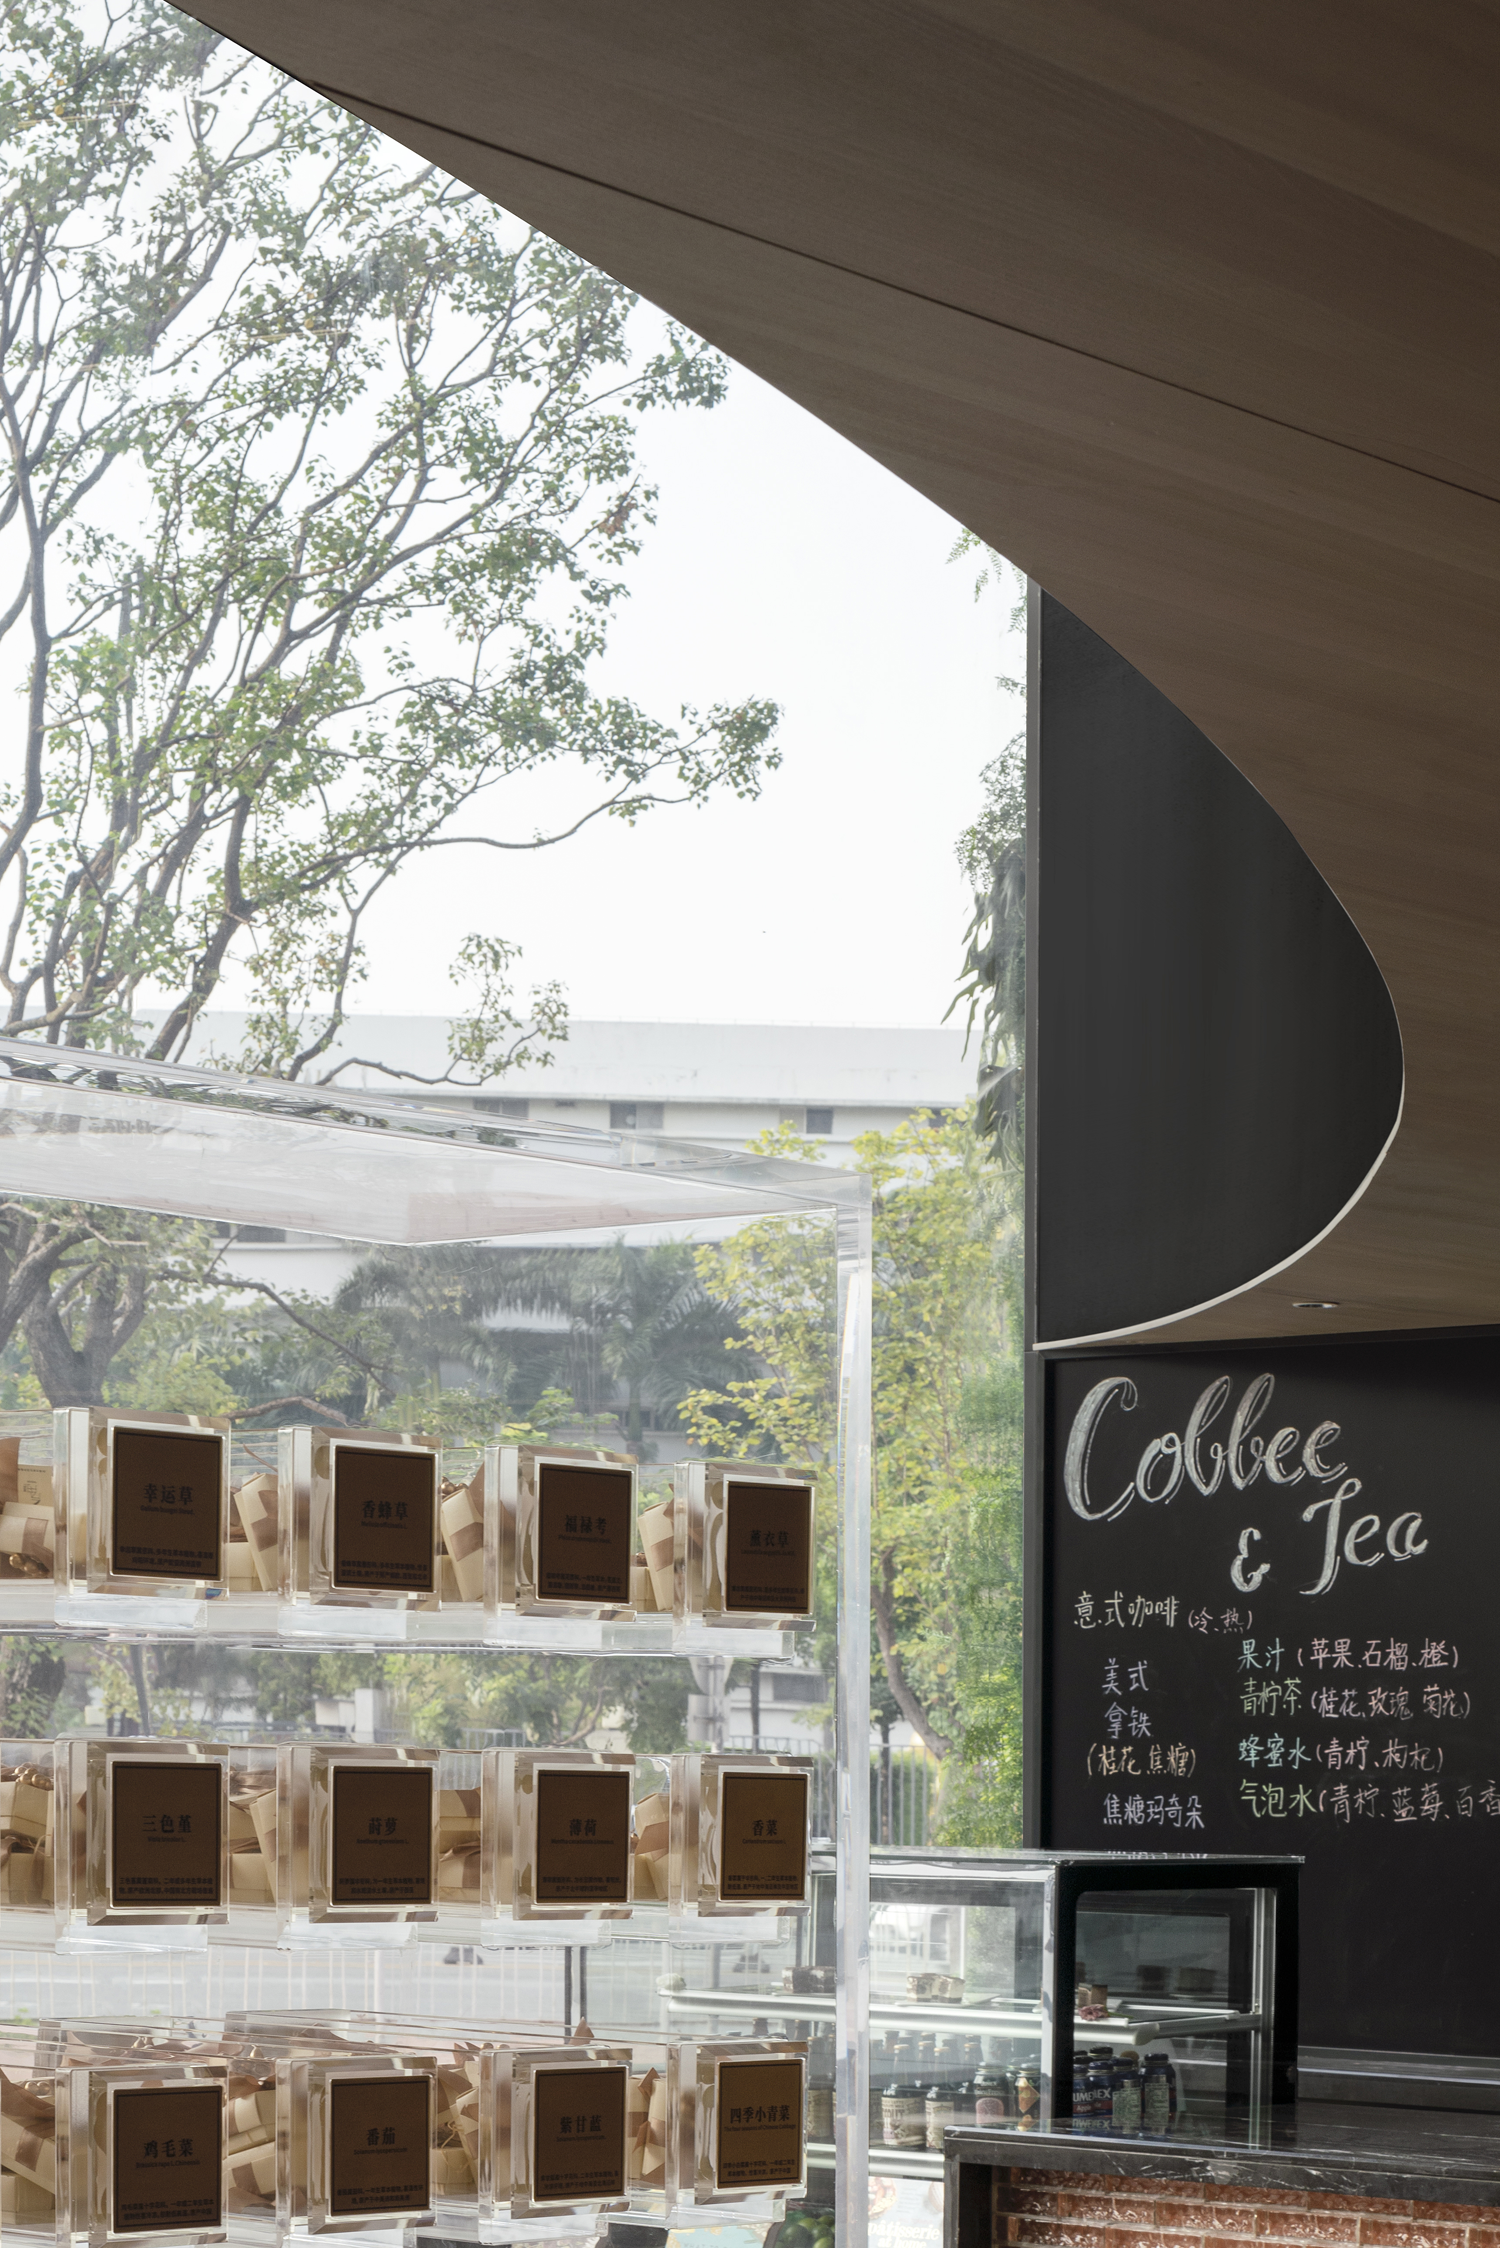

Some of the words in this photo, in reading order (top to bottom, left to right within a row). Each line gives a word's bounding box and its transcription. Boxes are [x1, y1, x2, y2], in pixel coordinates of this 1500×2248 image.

[1063, 1373, 1348, 1522] Coffee
[143, 1482, 194, 1506] 幸运草
[361, 1500, 409, 1521] 香蜂草
[564, 1514, 607, 1536] 福禄考
[1231, 1527, 1270, 1593] &
[1299, 1478, 1430, 1595] Tea
[749, 1529, 790, 1548] 薰衣草
[1074, 1590, 1180, 1629] 意式咖啡
[1237, 1638, 1285, 1673] 果汁
[1102, 1657, 1149, 1695] 美式
[1239, 1677, 1302, 1717] 青柠茶
[1104, 1701, 1152, 1739] 拿铁
[1238, 1733, 1312, 1770] 蜂蜜水
[1239, 1778, 1318, 1818] 气泡水
[1103, 1792, 1205, 1830] 焦糖玛奇朵
[142, 1814, 192, 1833] 三色堇
[368, 1816, 398, 1836] 莳萝
[569, 1818, 597, 1837] 薄荷
[752, 1819, 778, 1837] 香菜
[559, 2115, 602, 2134] 紫甘蓝
[730, 2104, 791, 2124] 四季小青菜
[366, 2127, 397, 2146] 番茄
[143, 2138, 194, 2159] 鸡毛菜
